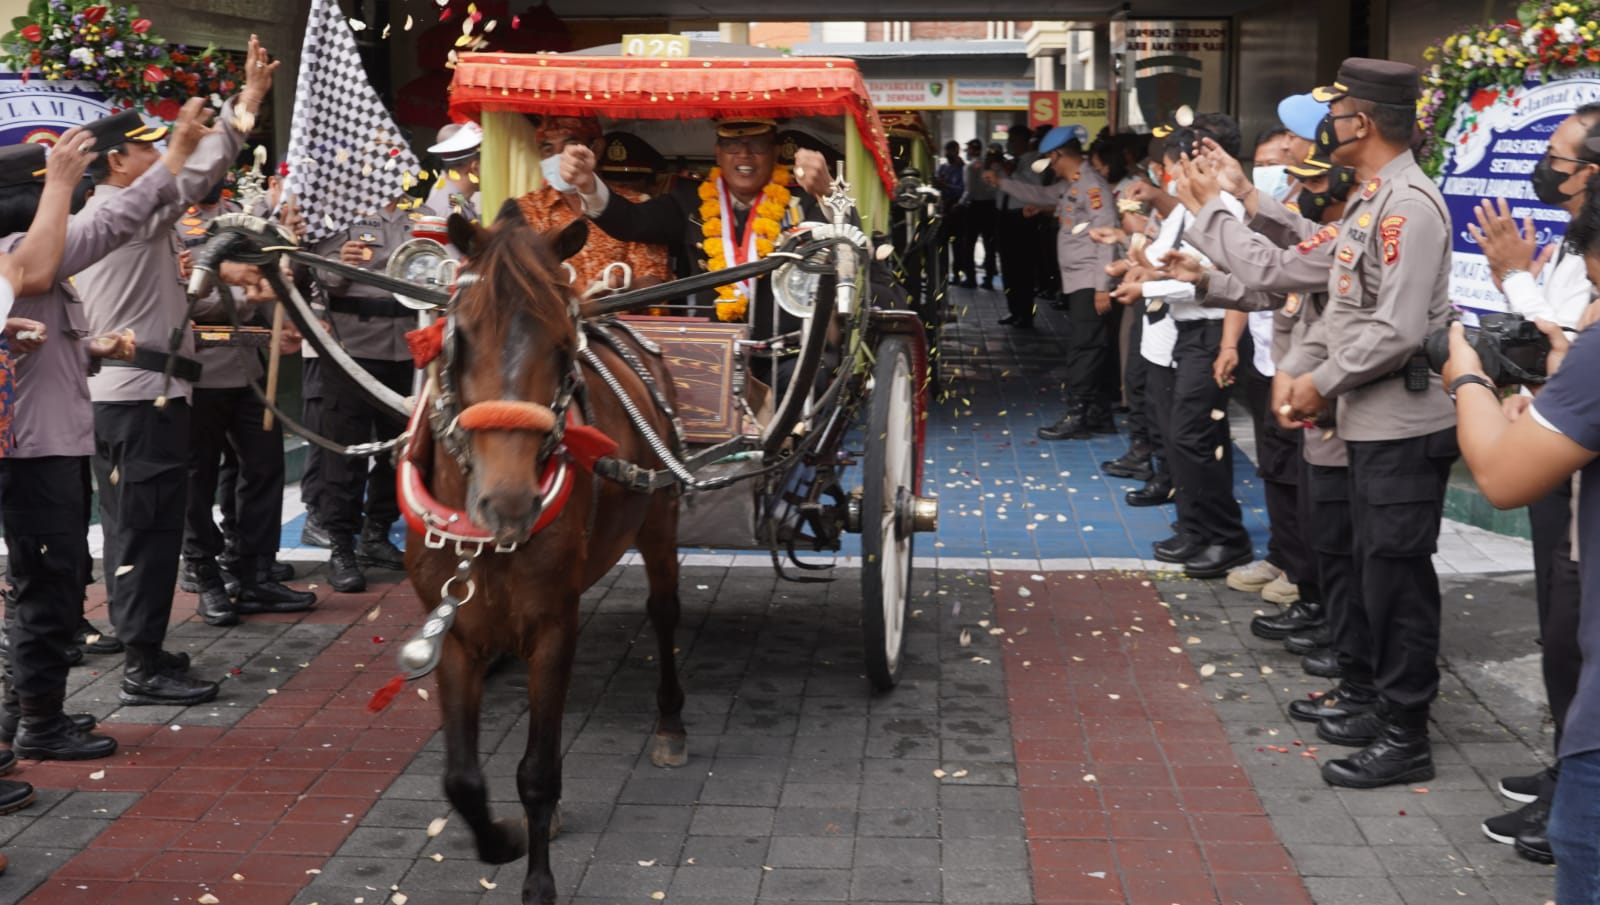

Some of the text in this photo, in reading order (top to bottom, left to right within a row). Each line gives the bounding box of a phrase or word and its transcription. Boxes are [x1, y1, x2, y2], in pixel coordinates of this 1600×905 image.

[628, 38, 683, 57] 026
[1034, 98, 1053, 121] S
[1062, 98, 1105, 109] WAJIB
[1489, 158, 1538, 174] SETINGK
